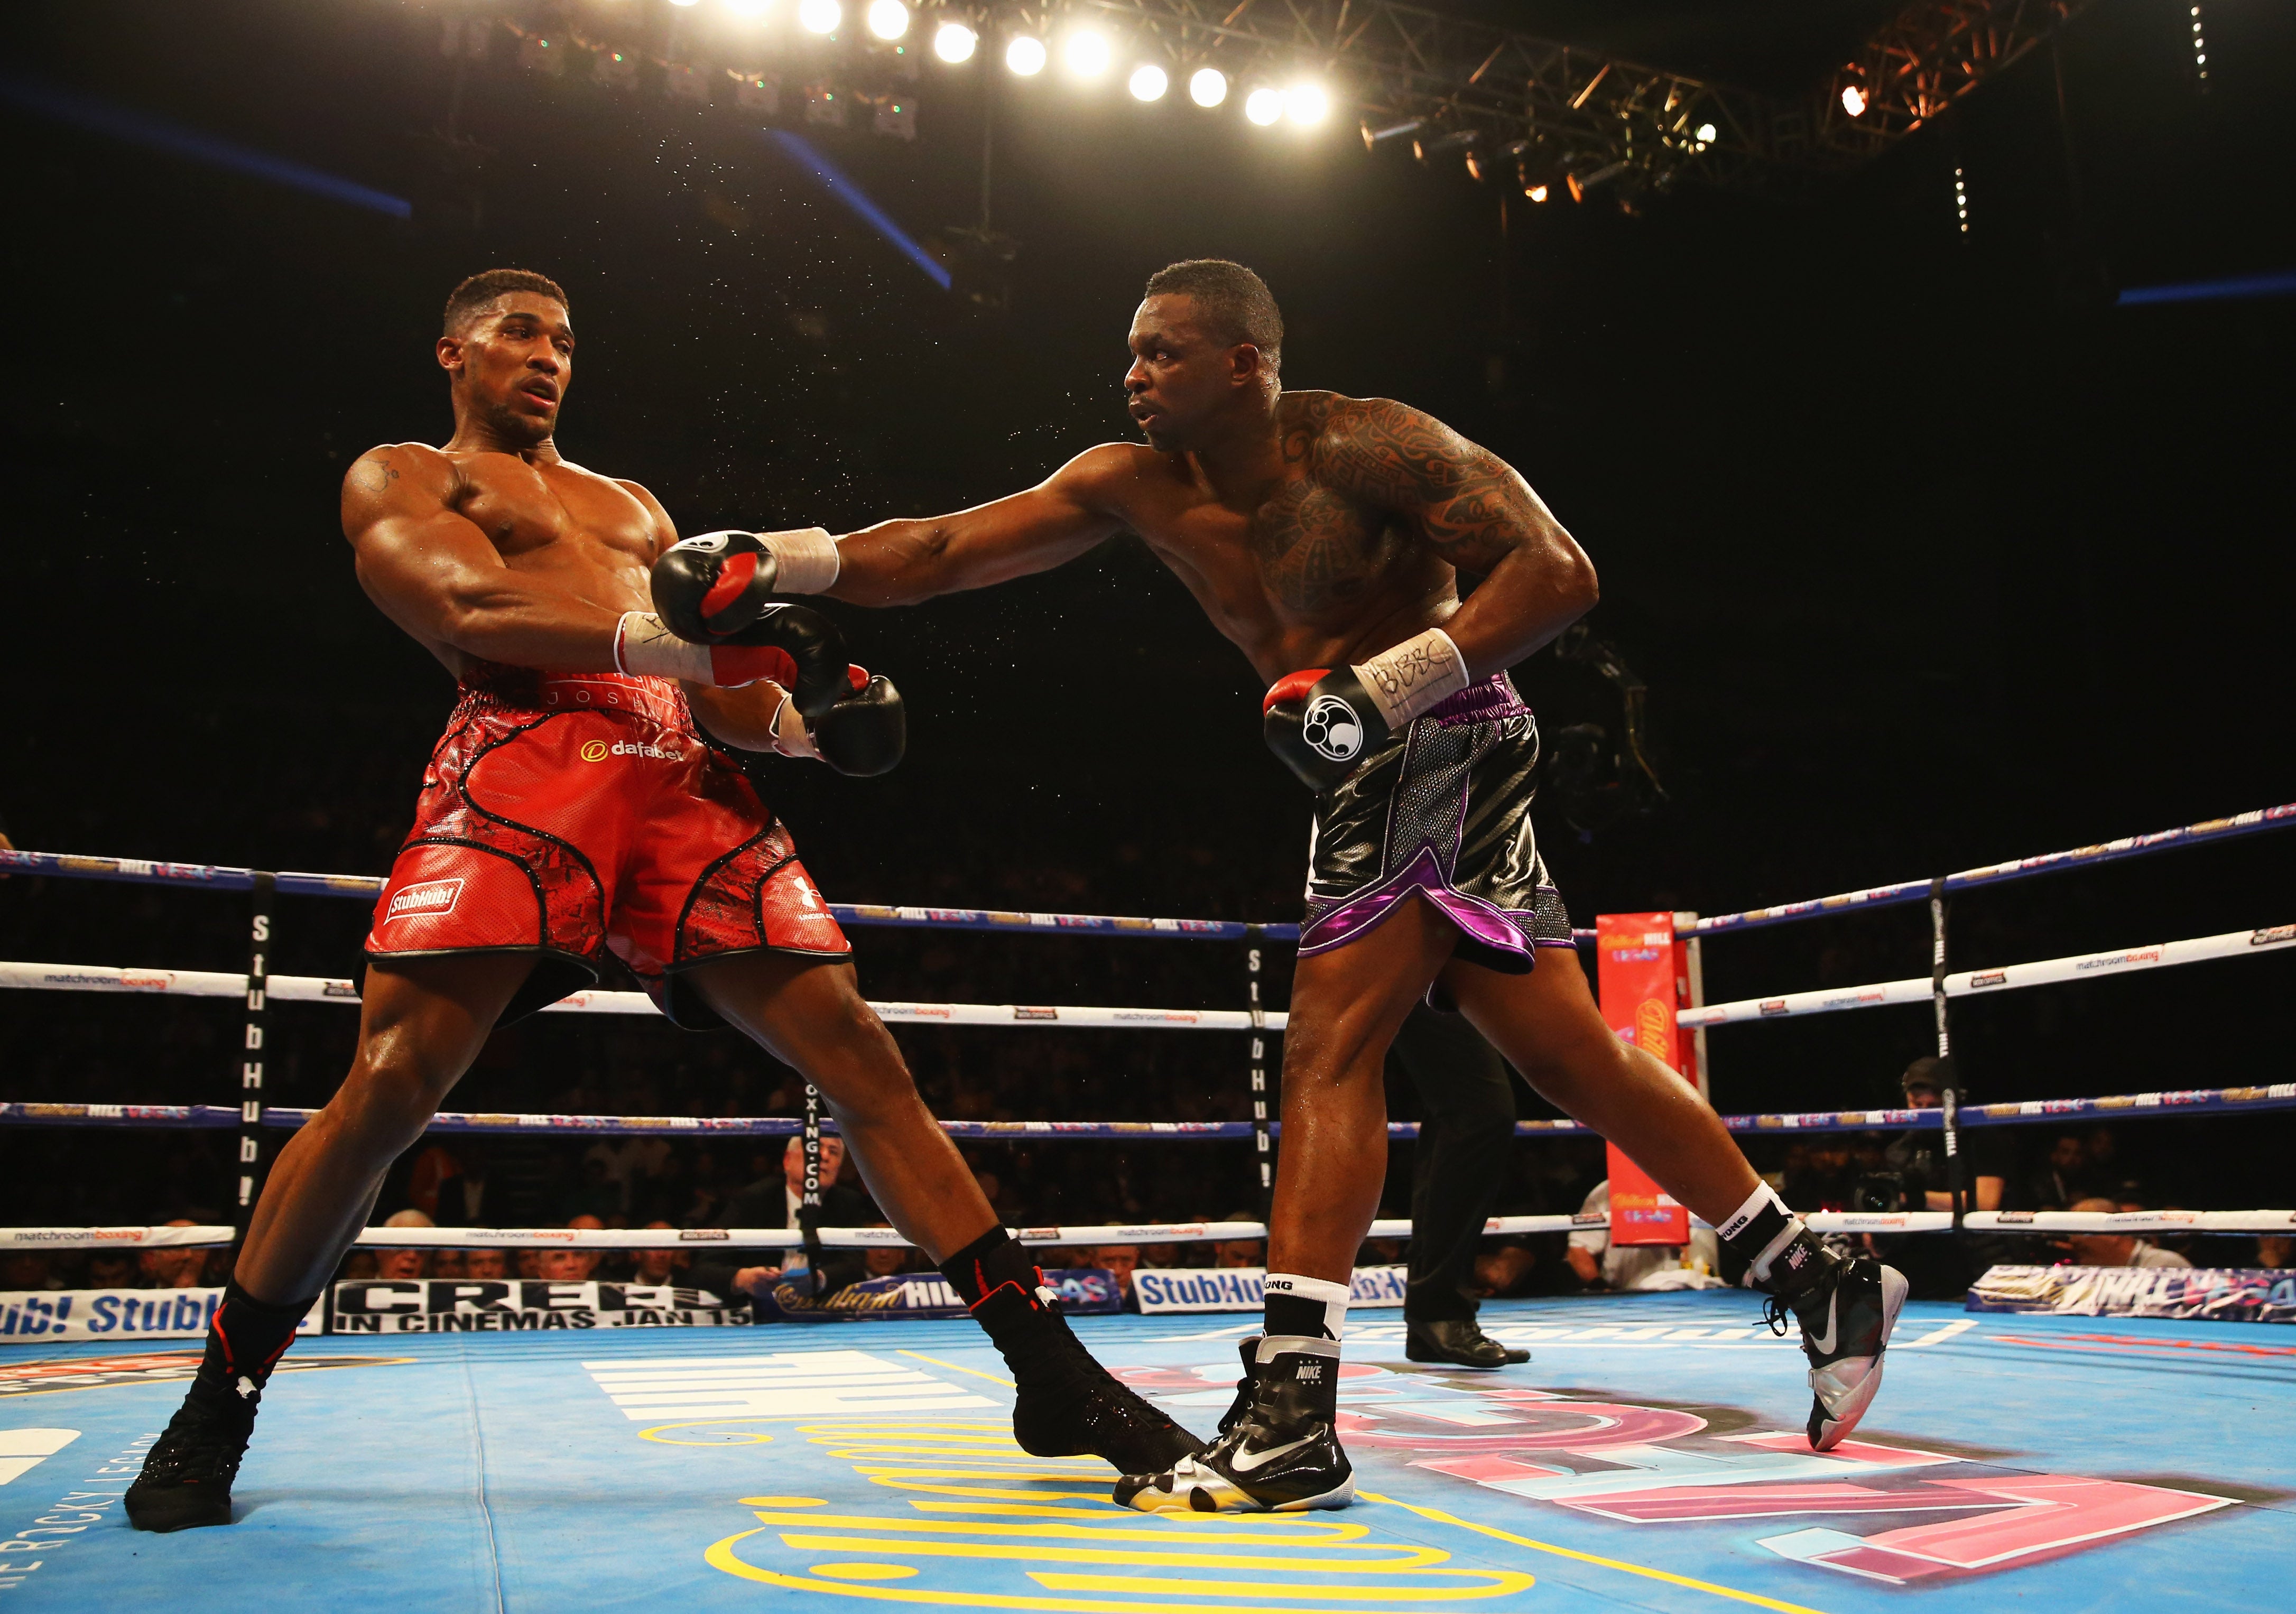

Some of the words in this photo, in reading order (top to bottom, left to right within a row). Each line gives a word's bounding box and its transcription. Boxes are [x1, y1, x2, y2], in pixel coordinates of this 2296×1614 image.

[546, 689, 680, 730] JOSHUA
[611, 740, 685, 762] dafabet
[391, 887, 455, 913] StubHub!
[1644, 932, 1671, 945] HILL
[14, 1230, 144, 1242] matchroomboxing
[1789, 1243, 1808, 1270] NIKE
[904, 1281, 966, 1308] HIL
[86, 1295, 218, 1332] Stub
[336, 1315, 381, 1331] IN
[398, 1311, 596, 1331] CINEMAS
[612, 1311, 693, 1325] JAN
[707, 1309, 752, 1325] 15
[1295, 1366, 1322, 1379] NIKE
